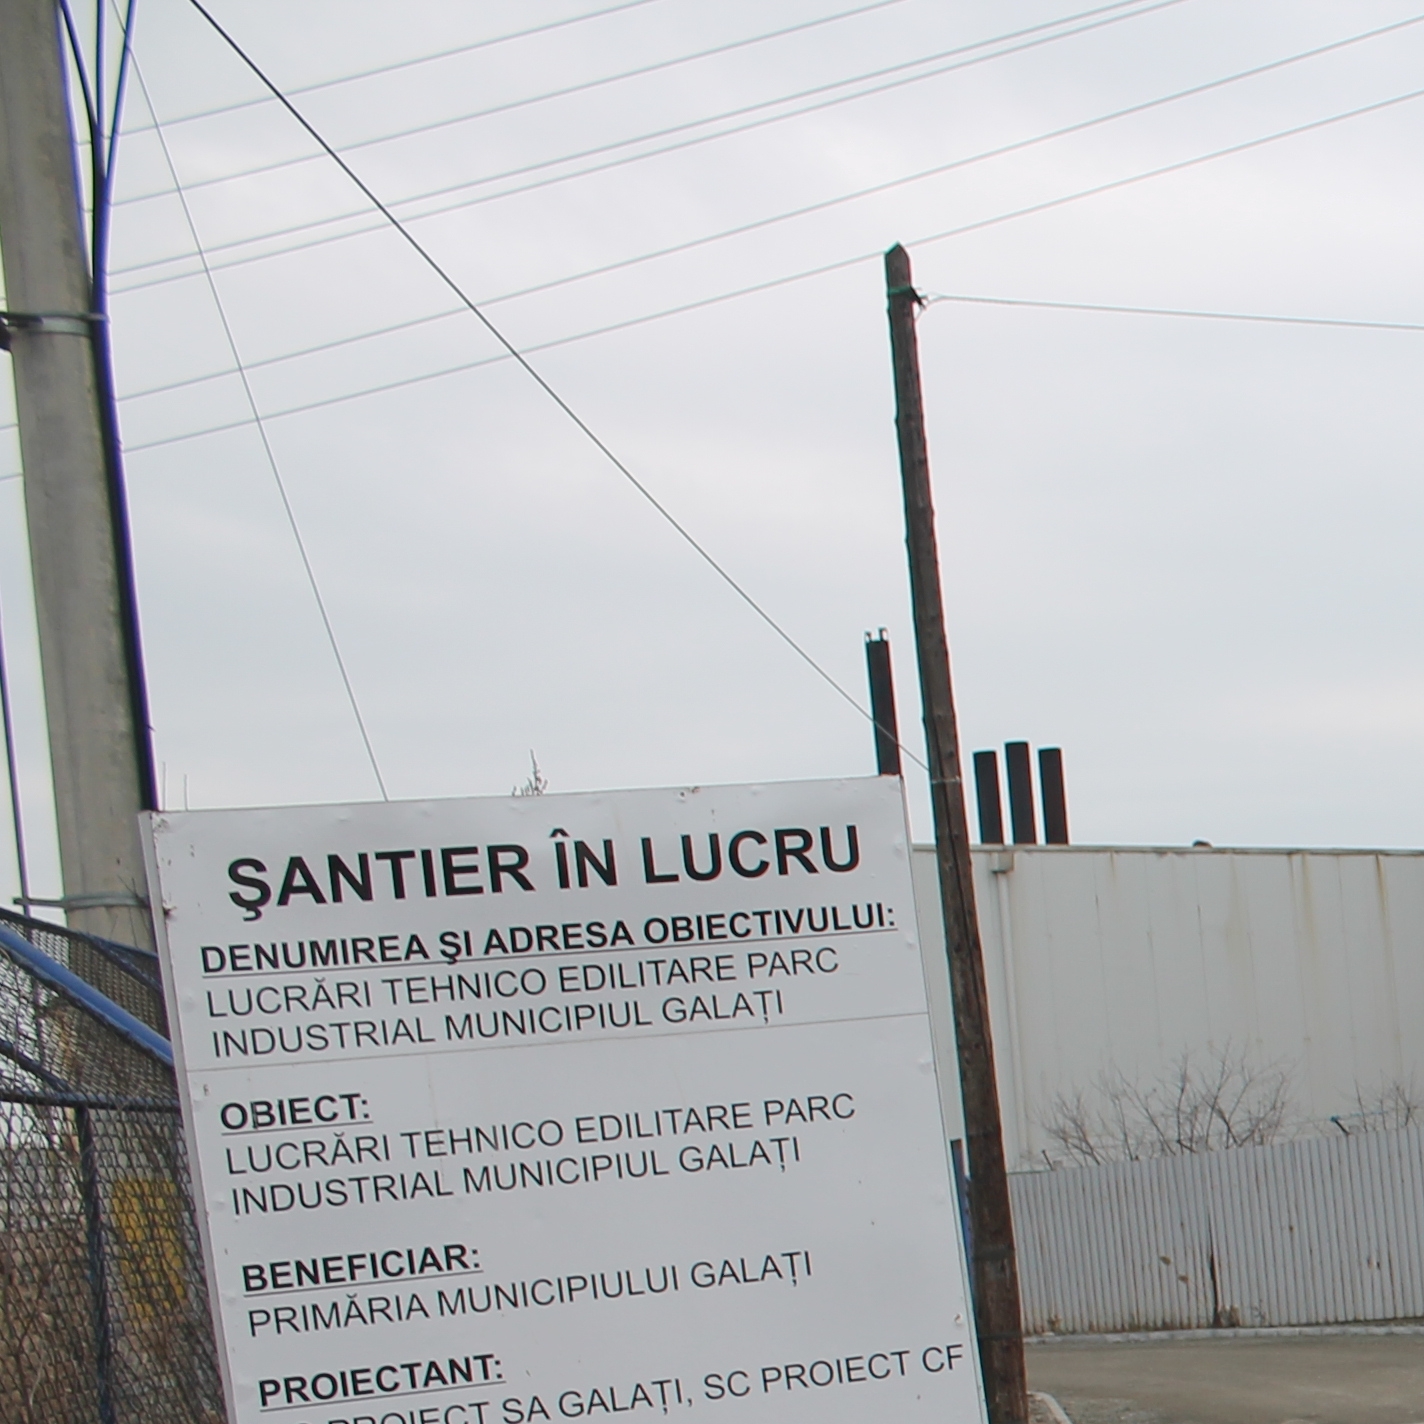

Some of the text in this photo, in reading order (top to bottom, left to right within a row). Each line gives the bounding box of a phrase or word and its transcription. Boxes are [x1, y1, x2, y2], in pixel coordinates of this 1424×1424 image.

[551, 828, 617, 888] ÎN
[644, 825, 861, 884] LUCRU
[201, 933, 428, 974] DENUMIREA
[484, 921, 635, 956] ADRESA
[644, 904, 895, 941] OBIECTIVULUI:
[206, 948, 839, 1019] LUCRĂRI TEHNICO EDILITARE PARC
[212, 1016, 436, 1058] INDUSTRIAL
[446, 1002, 652, 1040] MUNICIPIUL
[221, 1094, 371, 1132] OBIECT:
[225, 1094, 855, 1175] LUCRĂRI TEHNICO EDILITARE PARC
[230, 1171, 454, 1215] INDUSTRIAL
[463, 1153, 670, 1195] MUNICIPIUL
[243, 1245, 479, 1293] BENEFICIAR:
[249, 1290, 428, 1337] PRIMĂRIA
[438, 1267, 681, 1316] MUNICIPIULUI
[259, 1356, 503, 1407] PROIECTANT:
[705, 1373, 751, 1400] SC
[761, 1351, 912, 1391] PROIECT
[922, 1345, 962, 1373] CF
